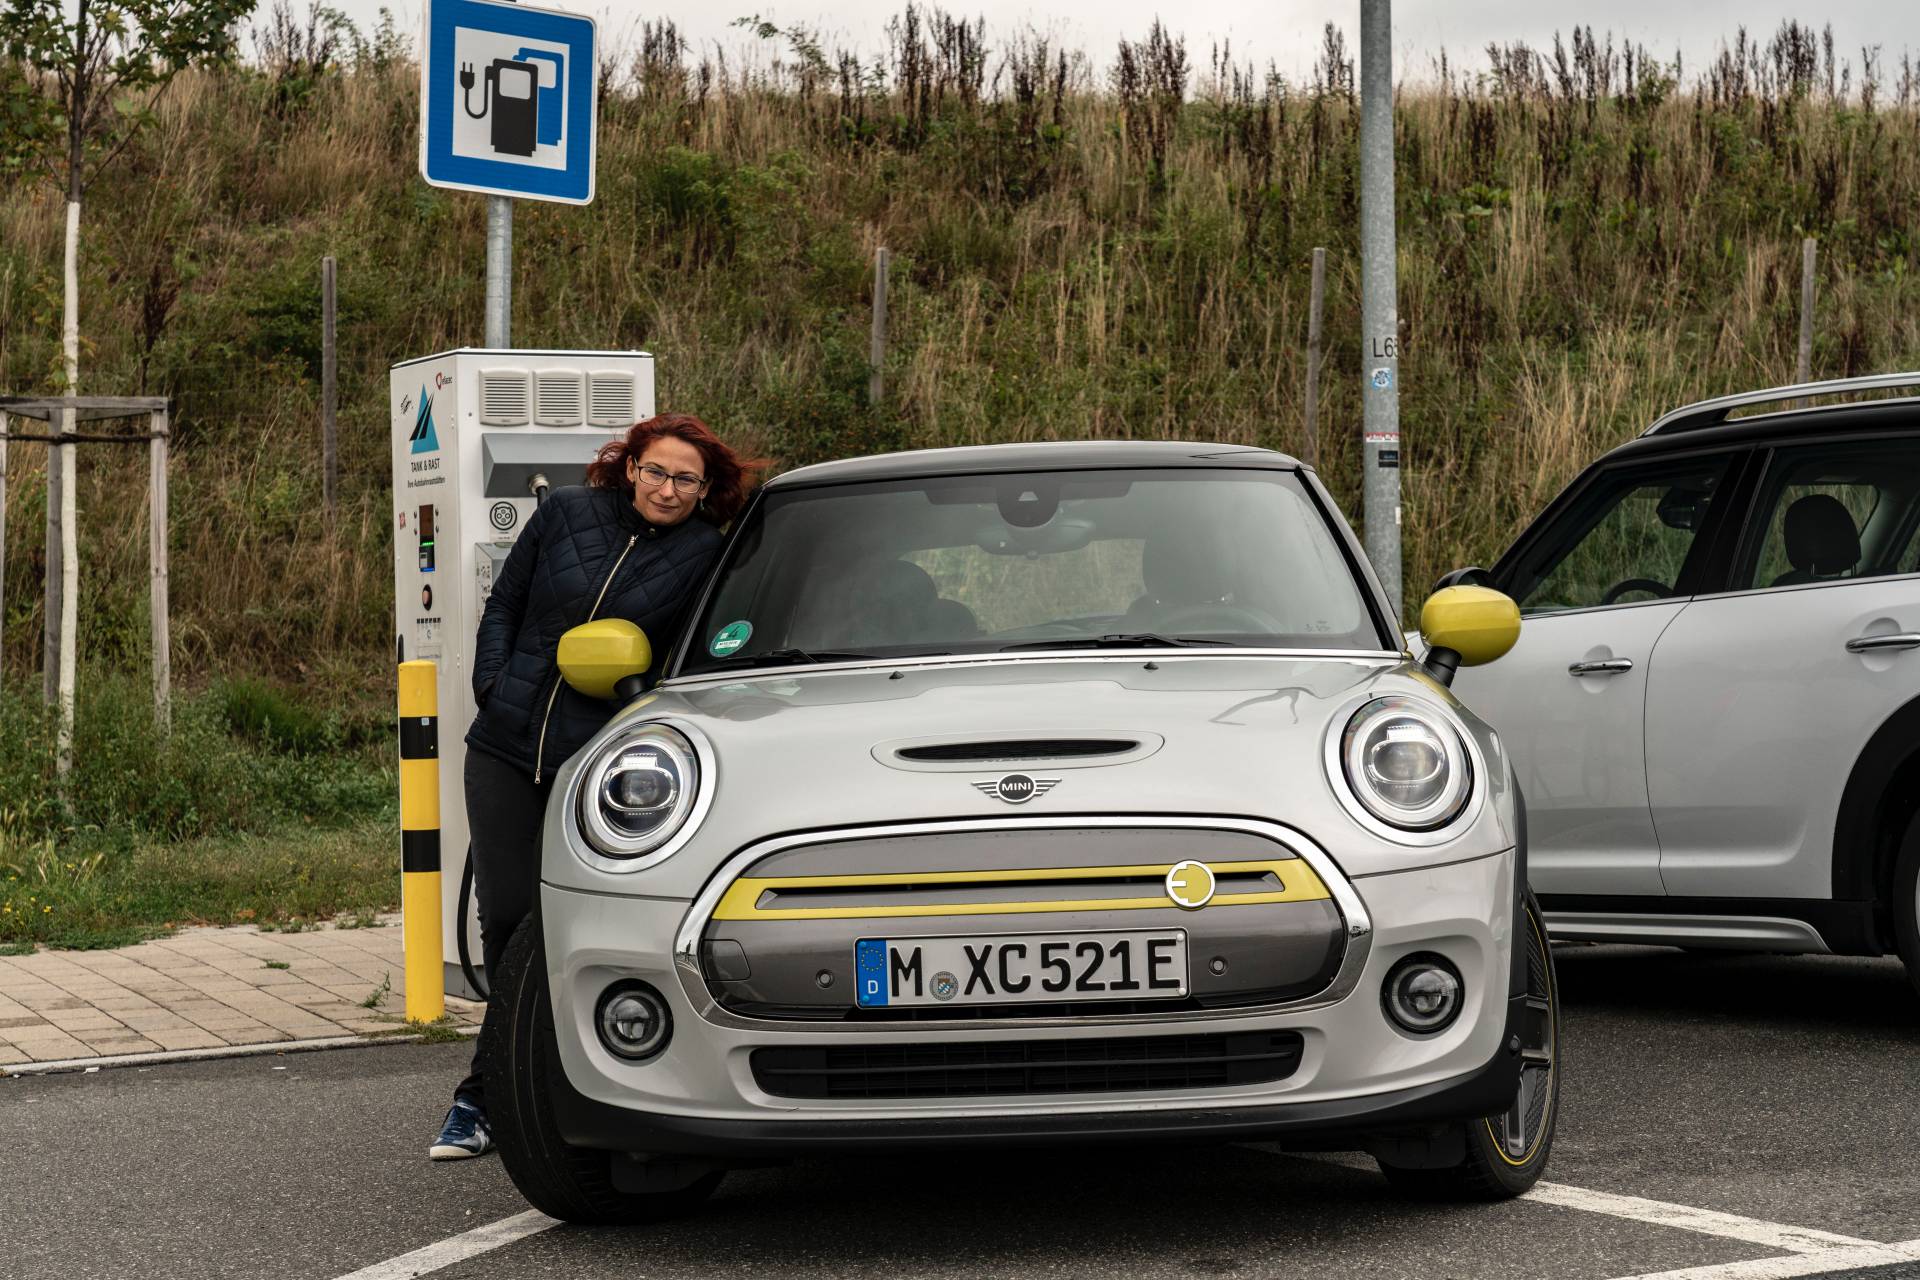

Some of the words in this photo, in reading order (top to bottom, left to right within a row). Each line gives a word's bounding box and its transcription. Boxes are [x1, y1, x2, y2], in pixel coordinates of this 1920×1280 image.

[411, 461, 423, 472] TANK
[424, 460, 428, 471] &
[428, 458, 440, 470] RAST
[1001, 782, 1031, 791] MINI
[890, 946, 923, 997] M
[867, 980, 878, 994] D
